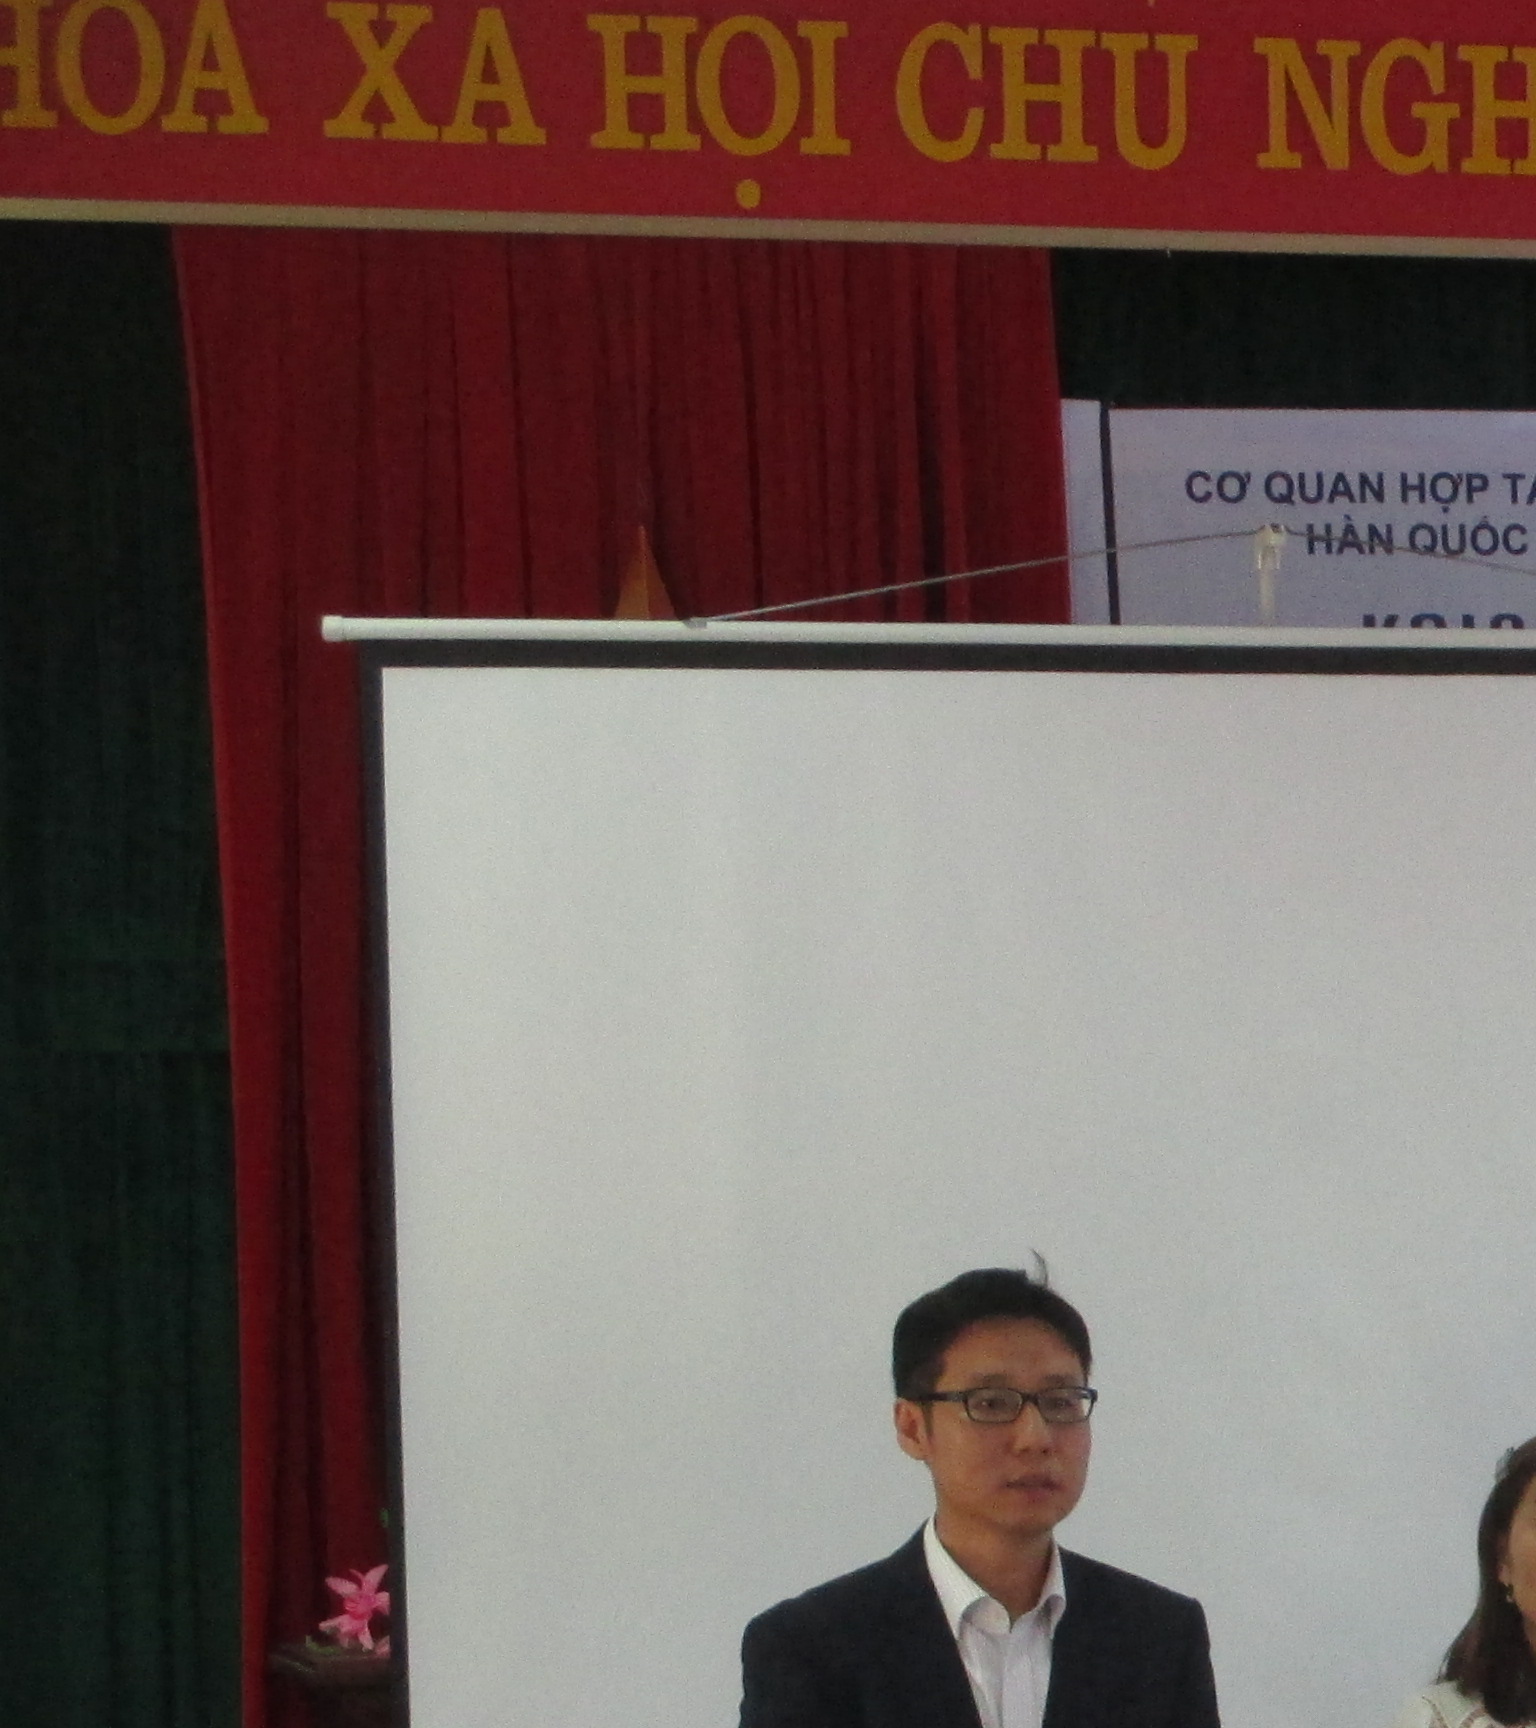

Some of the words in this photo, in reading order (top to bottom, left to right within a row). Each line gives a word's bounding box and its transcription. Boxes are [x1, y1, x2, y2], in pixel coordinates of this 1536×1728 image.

[1185, 470, 1251, 503] CƠ
[1264, 471, 1385, 505] QUAN
[1400, 470, 1489, 513] HỢP
[1306, 513, 1394, 556] HÀN
